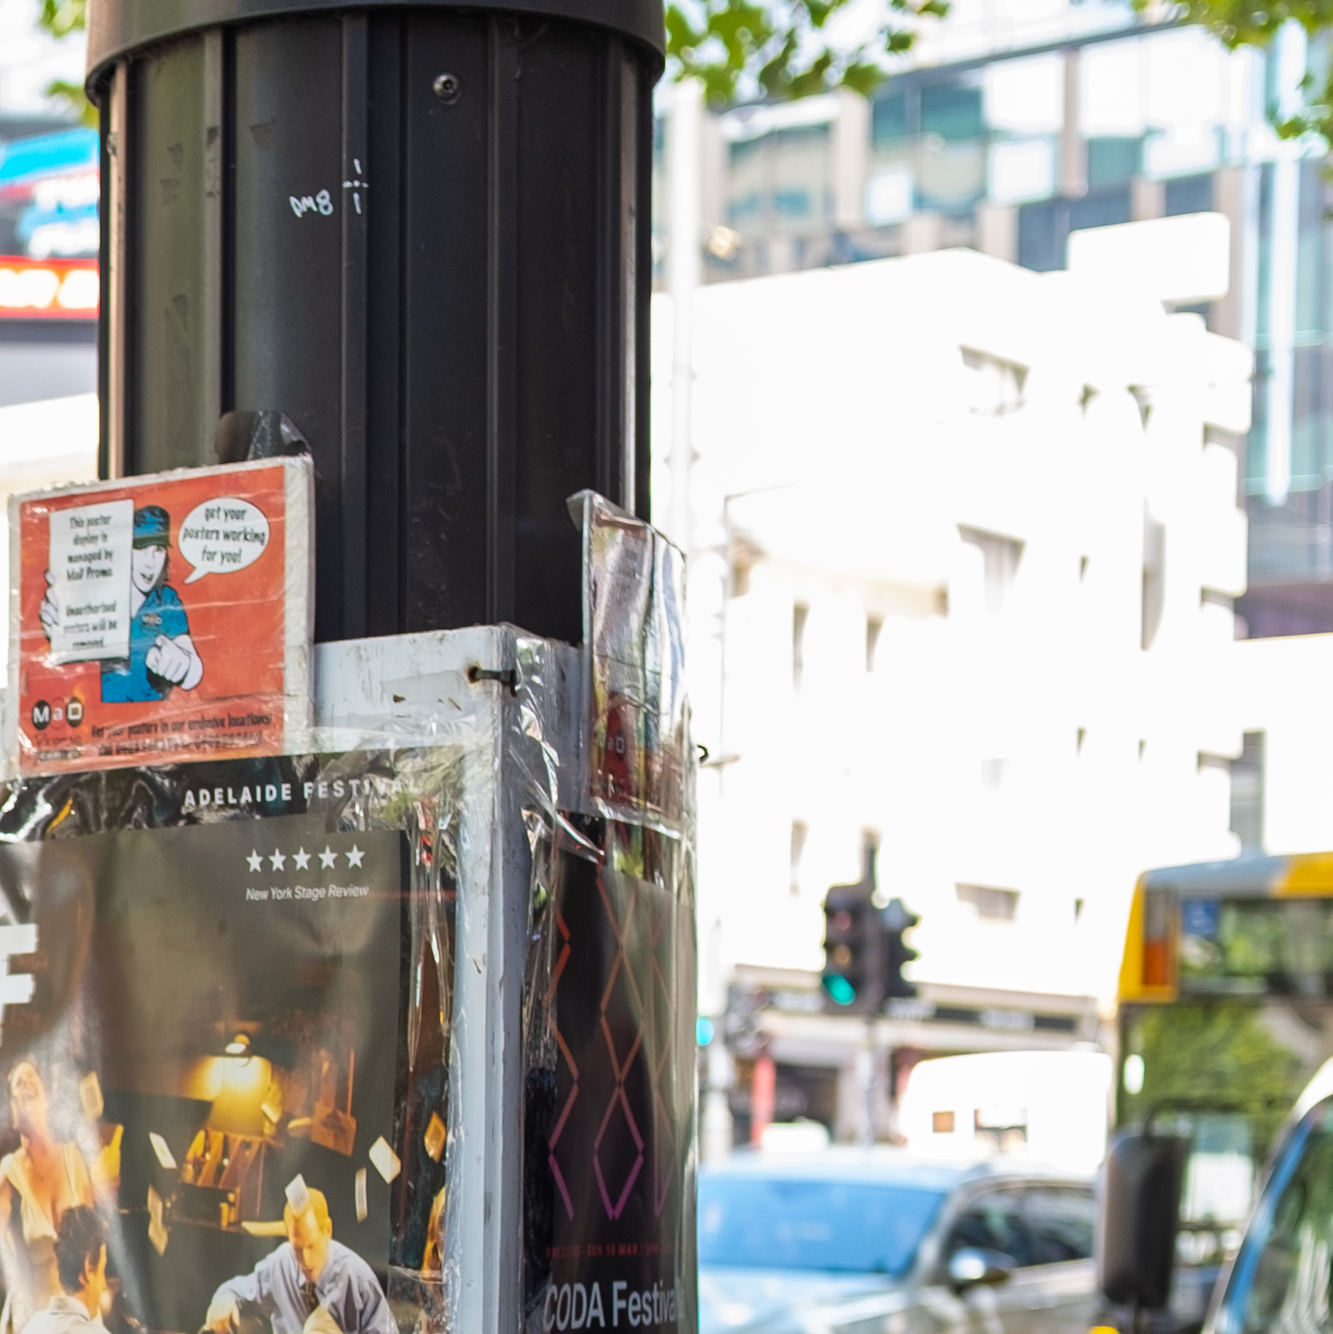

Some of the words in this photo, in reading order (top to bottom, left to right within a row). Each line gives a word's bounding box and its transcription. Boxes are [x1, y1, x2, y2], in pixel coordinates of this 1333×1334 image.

[224, 507, 247, 522] your
[183, 527, 220, 541] posters
[223, 523, 266, 546] working
[201, 547, 218, 563] for
[184, 783, 292, 807] ADELAIDE
[303, 778, 419, 800] FESTIVAL
[245, 888, 268, 901] New
[270, 885, 293, 900] York
[295, 884, 326, 901] Stage
[328, 883, 369, 899] Review
[543, 1281, 606, 1333] CODA
